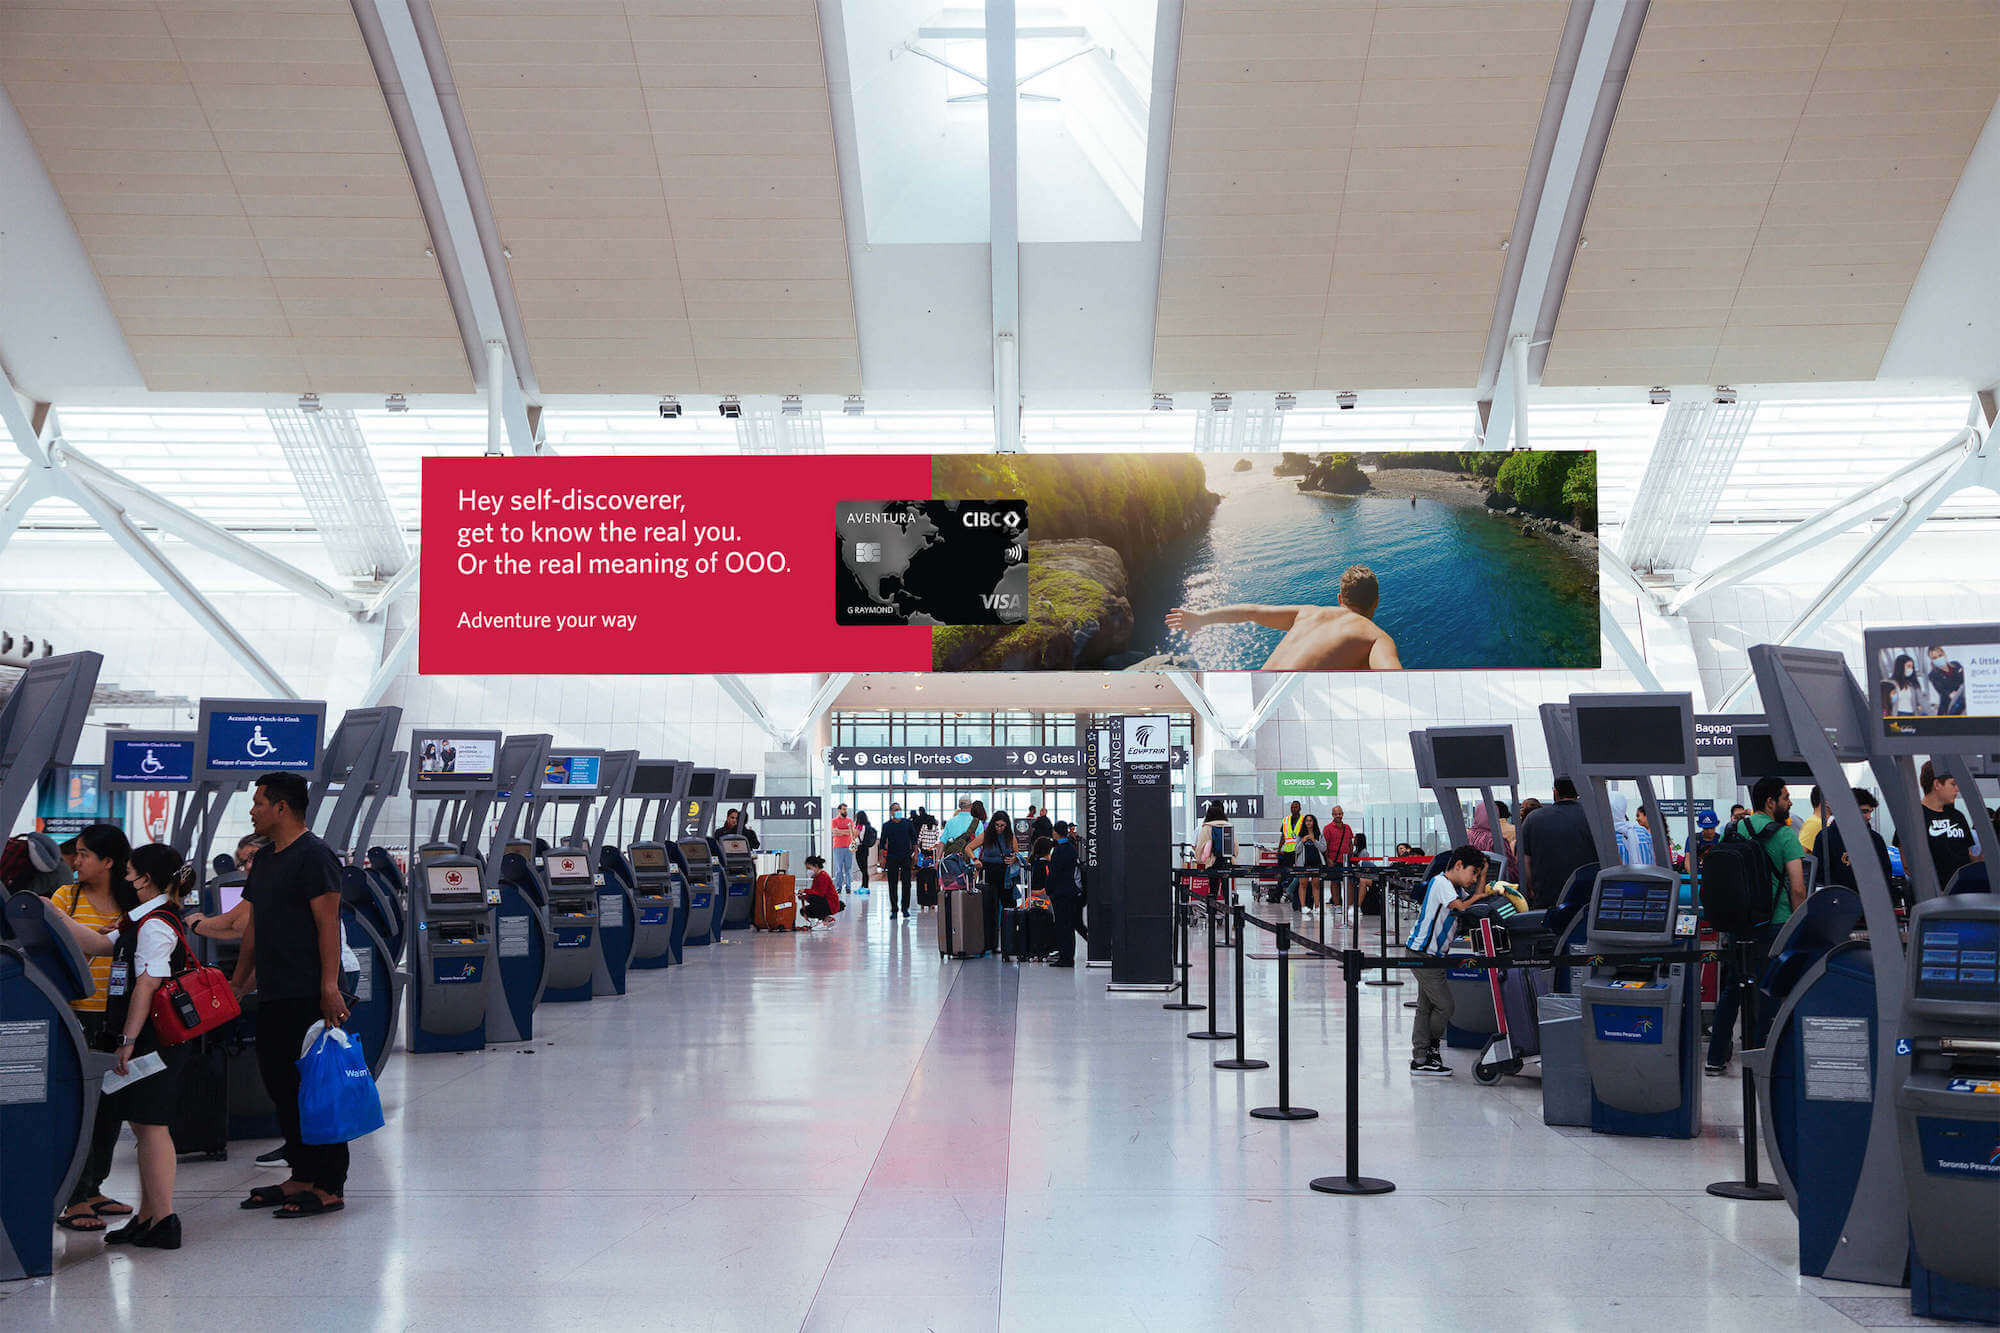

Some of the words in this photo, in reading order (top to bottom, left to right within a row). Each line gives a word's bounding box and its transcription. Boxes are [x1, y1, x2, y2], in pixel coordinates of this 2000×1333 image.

[458, 489, 504, 515] Hey
[510, 488, 685, 513] self-discoverer,
[847, 512, 916, 524] AVENTURA
[962, 511, 1002, 527] CIBC
[457, 522, 494, 548] get
[500, 522, 524, 543] to
[531, 520, 592, 543] know
[599, 520, 637, 542] the
[644, 519, 686, 542] real
[693, 525, 742, 547] you.
[457, 553, 487, 575] Or
[494, 552, 531, 575] the
[539, 552, 581, 574] real
[589, 552, 689, 579] meaning
[695, 551, 719, 574] of
[725, 551, 791, 574] OOO.
[847, 606, 854, 614] G
[854, 606, 894, 614] RAYMOND
[979, 594, 1020, 609] VISA
[456, 611, 551, 628] Adventure
[556, 614, 597, 631] your
[601, 614, 637, 631] way
[873, 752, 905, 764] Gates
[914, 752, 951, 764] Portes
[1042, 752, 1075, 764] Gates
[1088, 744, 1097, 775] GOLD
[1112, 732, 1122, 796] ALLIANCE
[1088, 781, 1097, 836] ALLIANCE
[1113, 798, 1122, 831] STAR
[1089, 838, 1098, 867] STAR
[1938, 1160, 1969, 1169] Toronto
